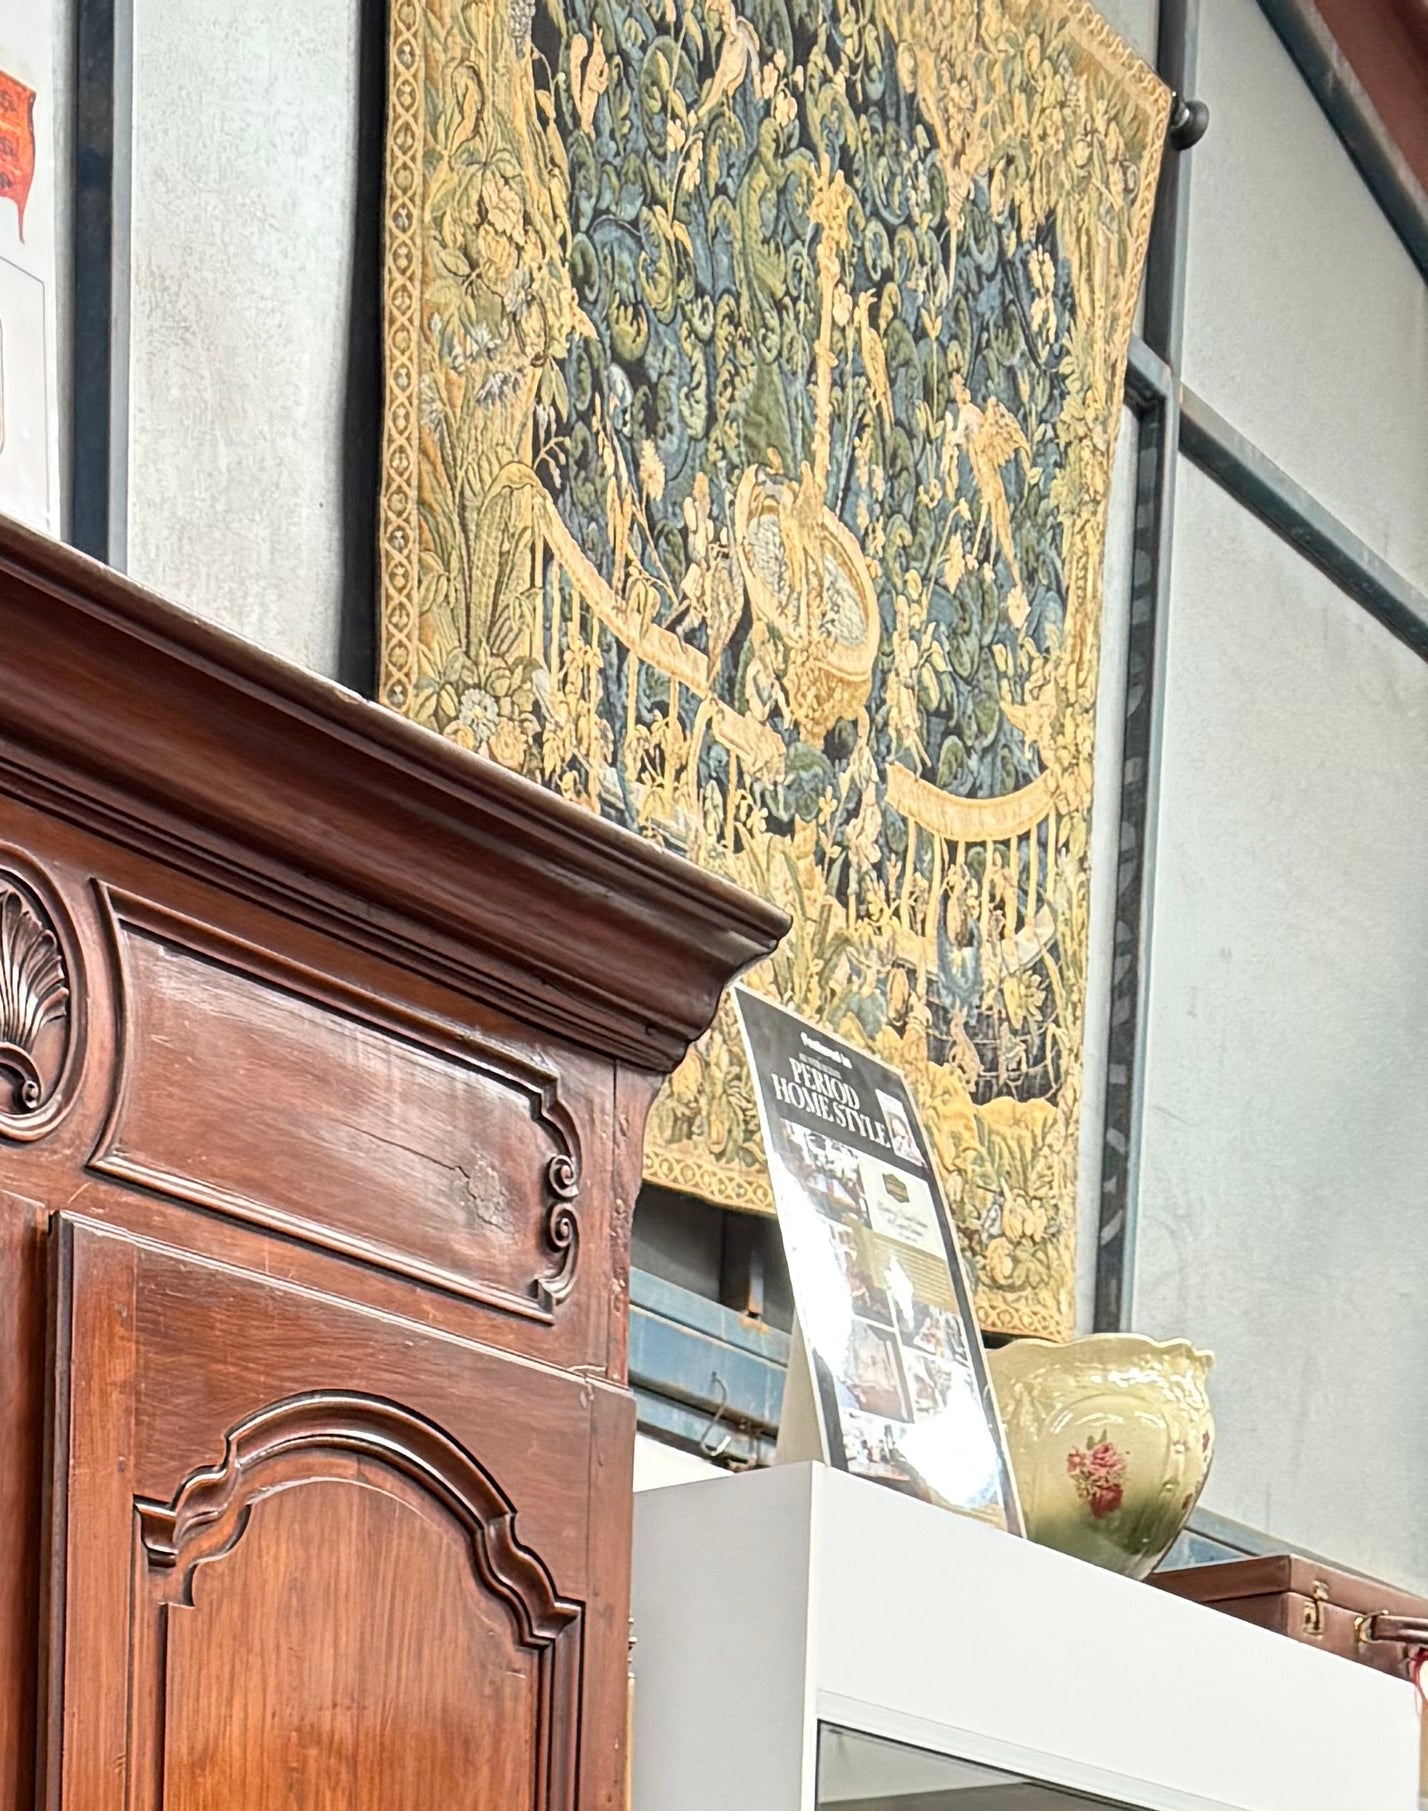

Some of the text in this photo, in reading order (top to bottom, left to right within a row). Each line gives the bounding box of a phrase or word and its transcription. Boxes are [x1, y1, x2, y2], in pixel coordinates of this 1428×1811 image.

[771, 1073, 892, 1148] HOME STYLE
[789, 1057, 861, 1111] PERIOD
